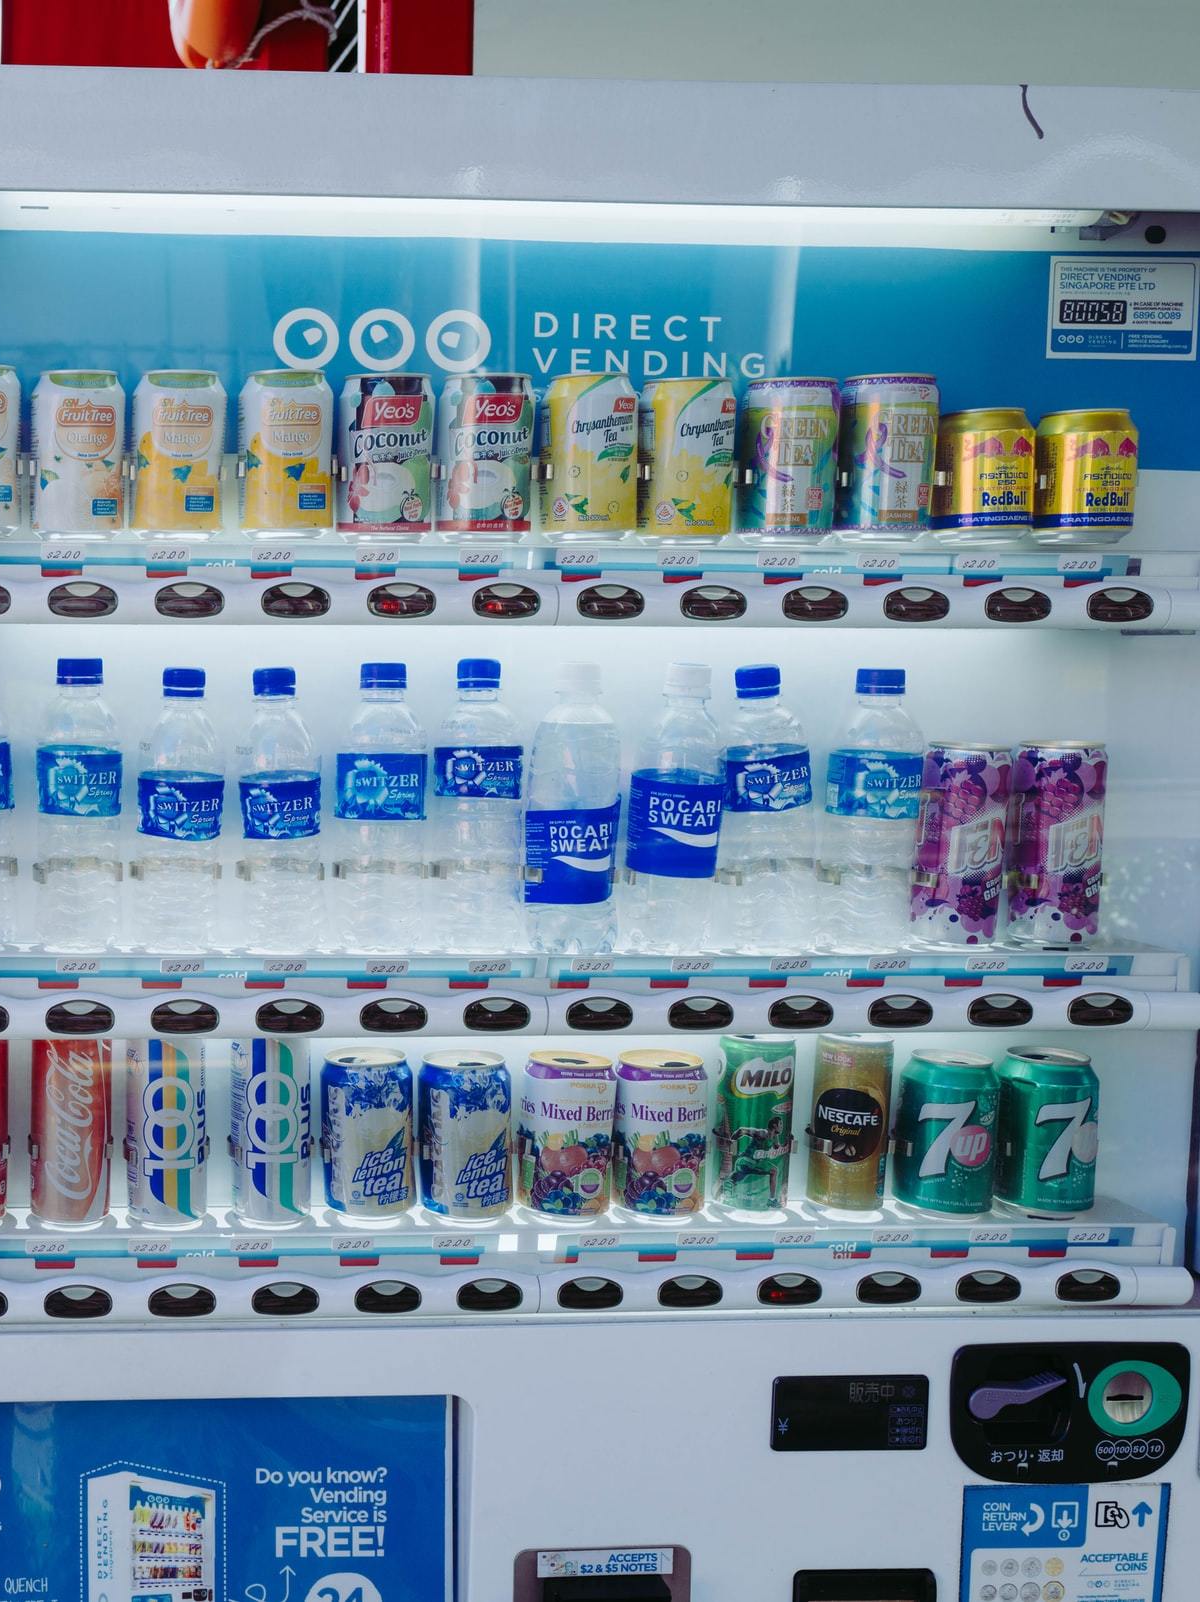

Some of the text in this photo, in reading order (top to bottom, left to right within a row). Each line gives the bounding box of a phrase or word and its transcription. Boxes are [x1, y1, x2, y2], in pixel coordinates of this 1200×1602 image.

[1060, 273, 1141, 282] DIRECT VENDING
[1059, 282, 1156, 291] SINGAPORE PTE LTD
[1133, 312, 1181, 320] 6896 0089
[534, 311, 722, 342] DIRECT
[532, 348, 766, 378] VENDING
[61, 408, 113, 422] Fruit Tree
[158, 408, 209, 422] Fruit Tree
[295, 408, 317, 421] Tree
[374, 402, 415, 421] Yeo's
[475, 400, 516, 417] Yeo's
[572, 414, 634, 436] Chrysanthemum
[761, 413, 830, 440] GREEN
[878, 409, 938, 436] GREEN
[67, 431, 107, 447] Orange
[163, 431, 201, 447] Mango
[273, 431, 311, 446] Mango
[455, 427, 529, 456] Coconut
[604, 431, 618, 443] Tea
[711, 433, 724, 447] Tea
[354, 430, 427, 458] Coconut
[890, 436, 924, 463] TEA
[777, 439, 815, 466] TEA
[981, 490, 1027, 507] RedBull
[1086, 492, 1129, 507] RedBull
[958, 515, 1028, 524] KRATINGDAENG
[1060, 516, 1129, 524] KRATINGDAENG
[47, 550, 81, 559] $2.00
[152, 551, 185, 560] $2.00
[257, 551, 291, 561] $2.00
[360, 552, 394, 562] $2.00
[465, 554, 498, 563] $2.00
[561, 555, 594, 564] $2.00
[662, 556, 695, 565] $2.00
[763, 557, 796, 566] $2.00
[863, 559, 896, 568] $2.00
[963, 560, 996, 569] $2.00
[1063, 560, 1097, 570] $2.00
[455, 760, 514, 773] SWITZER
[57, 771, 117, 786] SWITZER
[355, 773, 419, 788] SWITZER
[746, 766, 809, 787] SWITZER
[866, 774, 922, 789] SWITZER
[87, 786, 115, 799] Spring
[388, 789, 416, 801] Spring
[156, 798, 220, 812] SWITZER
[252, 796, 313, 813] SWITZER
[649, 796, 721, 813] POCARI
[190, 814, 216, 825] Spring
[283, 813, 310, 825] Spring
[648, 809, 716, 827] SWEAT
[549, 821, 612, 839] POCARI
[550, 836, 609, 853] SWEAT
[62, 963, 95, 972] $2.00
[167, 963, 200, 972] $2.00
[269, 963, 302, 972] $2.00
[371, 964, 405, 973] $2.00
[473, 963, 506, 973] $2.00
[577, 962, 610, 971] $3.00
[775, 961, 808, 970] $2.00
[873, 961, 907, 970] $2.00
[972, 961, 1005, 970] $2.00
[1070, 961, 1104, 970] $2.00
[740, 1067, 792, 1088] MILO
[540, 1101, 582, 1122] Mixed
[631, 1103, 673, 1123] Mixed
[818, 1104, 880, 1126] NESCAFÉ
[143, 1076, 195, 1177] 100
[245, 1071, 299, 1170] 100
[830, 1124, 862, 1136] Original
[918, 1100, 988, 1178] 7 up
[1036, 1097, 1091, 1182] 7
[363, 1148, 393, 1169] ice
[466, 1150, 497, 1171] ice
[353, 1154, 406, 1183] lemon
[456, 1155, 507, 1185] lemon
[364, 1173, 401, 1197] tea
[467, 1175, 504, 1199] tea
[583, 1238, 616, 1247] $2.00
[681, 1236, 714, 1245] $2.00
[779, 1234, 812, 1243] $2.00
[876, 1233, 910, 1242] $2.00
[975, 1233, 1008, 1242] $2.00
[1072, 1232, 1105, 1241] $2.00
[32, 1244, 65, 1253] $2.00
[133, 1243, 167, 1252] $2.00
[235, 1242, 269, 1251] $2.00
[337, 1240, 370, 1249] $2.00
[438, 1239, 471, 1248] $2.00
[828, 1241, 856, 1253] cold
[849, 1382, 895, 1403] 販売中
[777, 1417, 789, 1435] ¥
[1098, 1445, 1161, 1454] 500 100 50 10
[990, 1449, 1064, 1464] おつり・返却
[255, 1467, 387, 1487] Do you know?
[310, 1486, 387, 1506] Vending
[982, 1502, 1011, 1512] COIN
[301, 1507, 387, 1524] Service is
[982, 1512, 1027, 1522] RETURN
[982, 1522, 1018, 1532] LEVER
[275, 1525, 385, 1558] FREE!
[608, 1553, 658, 1564] ACCEPTS
[1080, 1553, 1149, 1563] ACCEPTABLE
[580, 1562, 658, 1574] $2 & $5 NOTES
[1115, 1562, 1148, 1572] COINS
[4, 1577, 49, 1594] QUENCH
